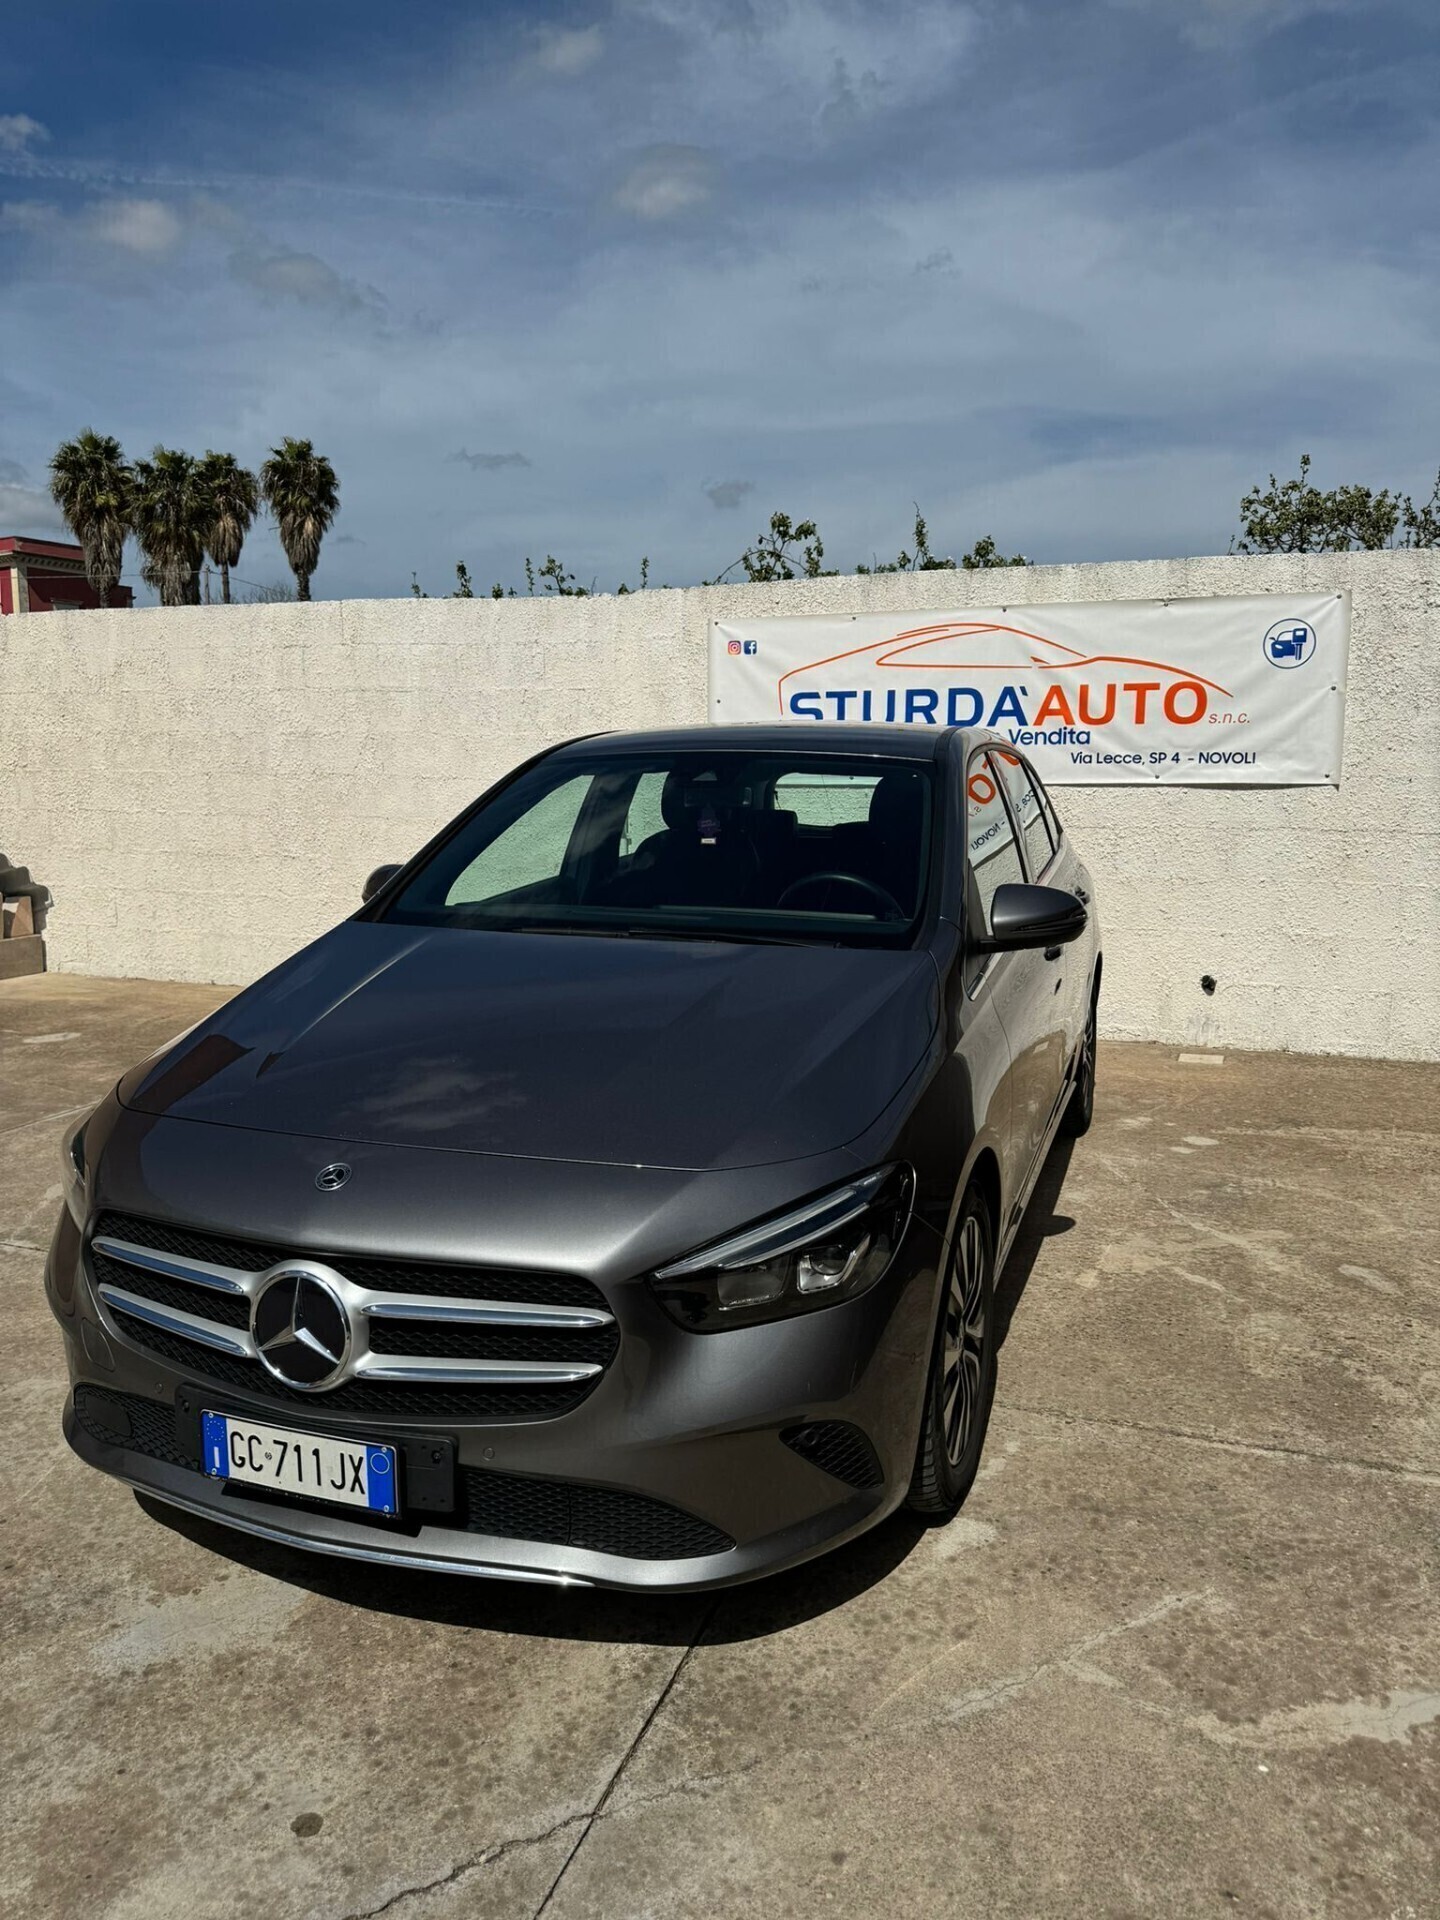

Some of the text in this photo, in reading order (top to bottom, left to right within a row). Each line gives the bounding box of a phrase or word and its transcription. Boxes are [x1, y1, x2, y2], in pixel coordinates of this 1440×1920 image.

[1208, 711, 1250, 724] s.n.c.
[1008, 726, 1091, 746] Vendita
[1070, 752, 1092, 764] Via
[1096, 752, 1146, 766] Lecce,
[1149, 752, 1167, 764] SP
[1171, 752, 1181, 764] 4
[1198, 752, 1256, 764] NOVOLI
